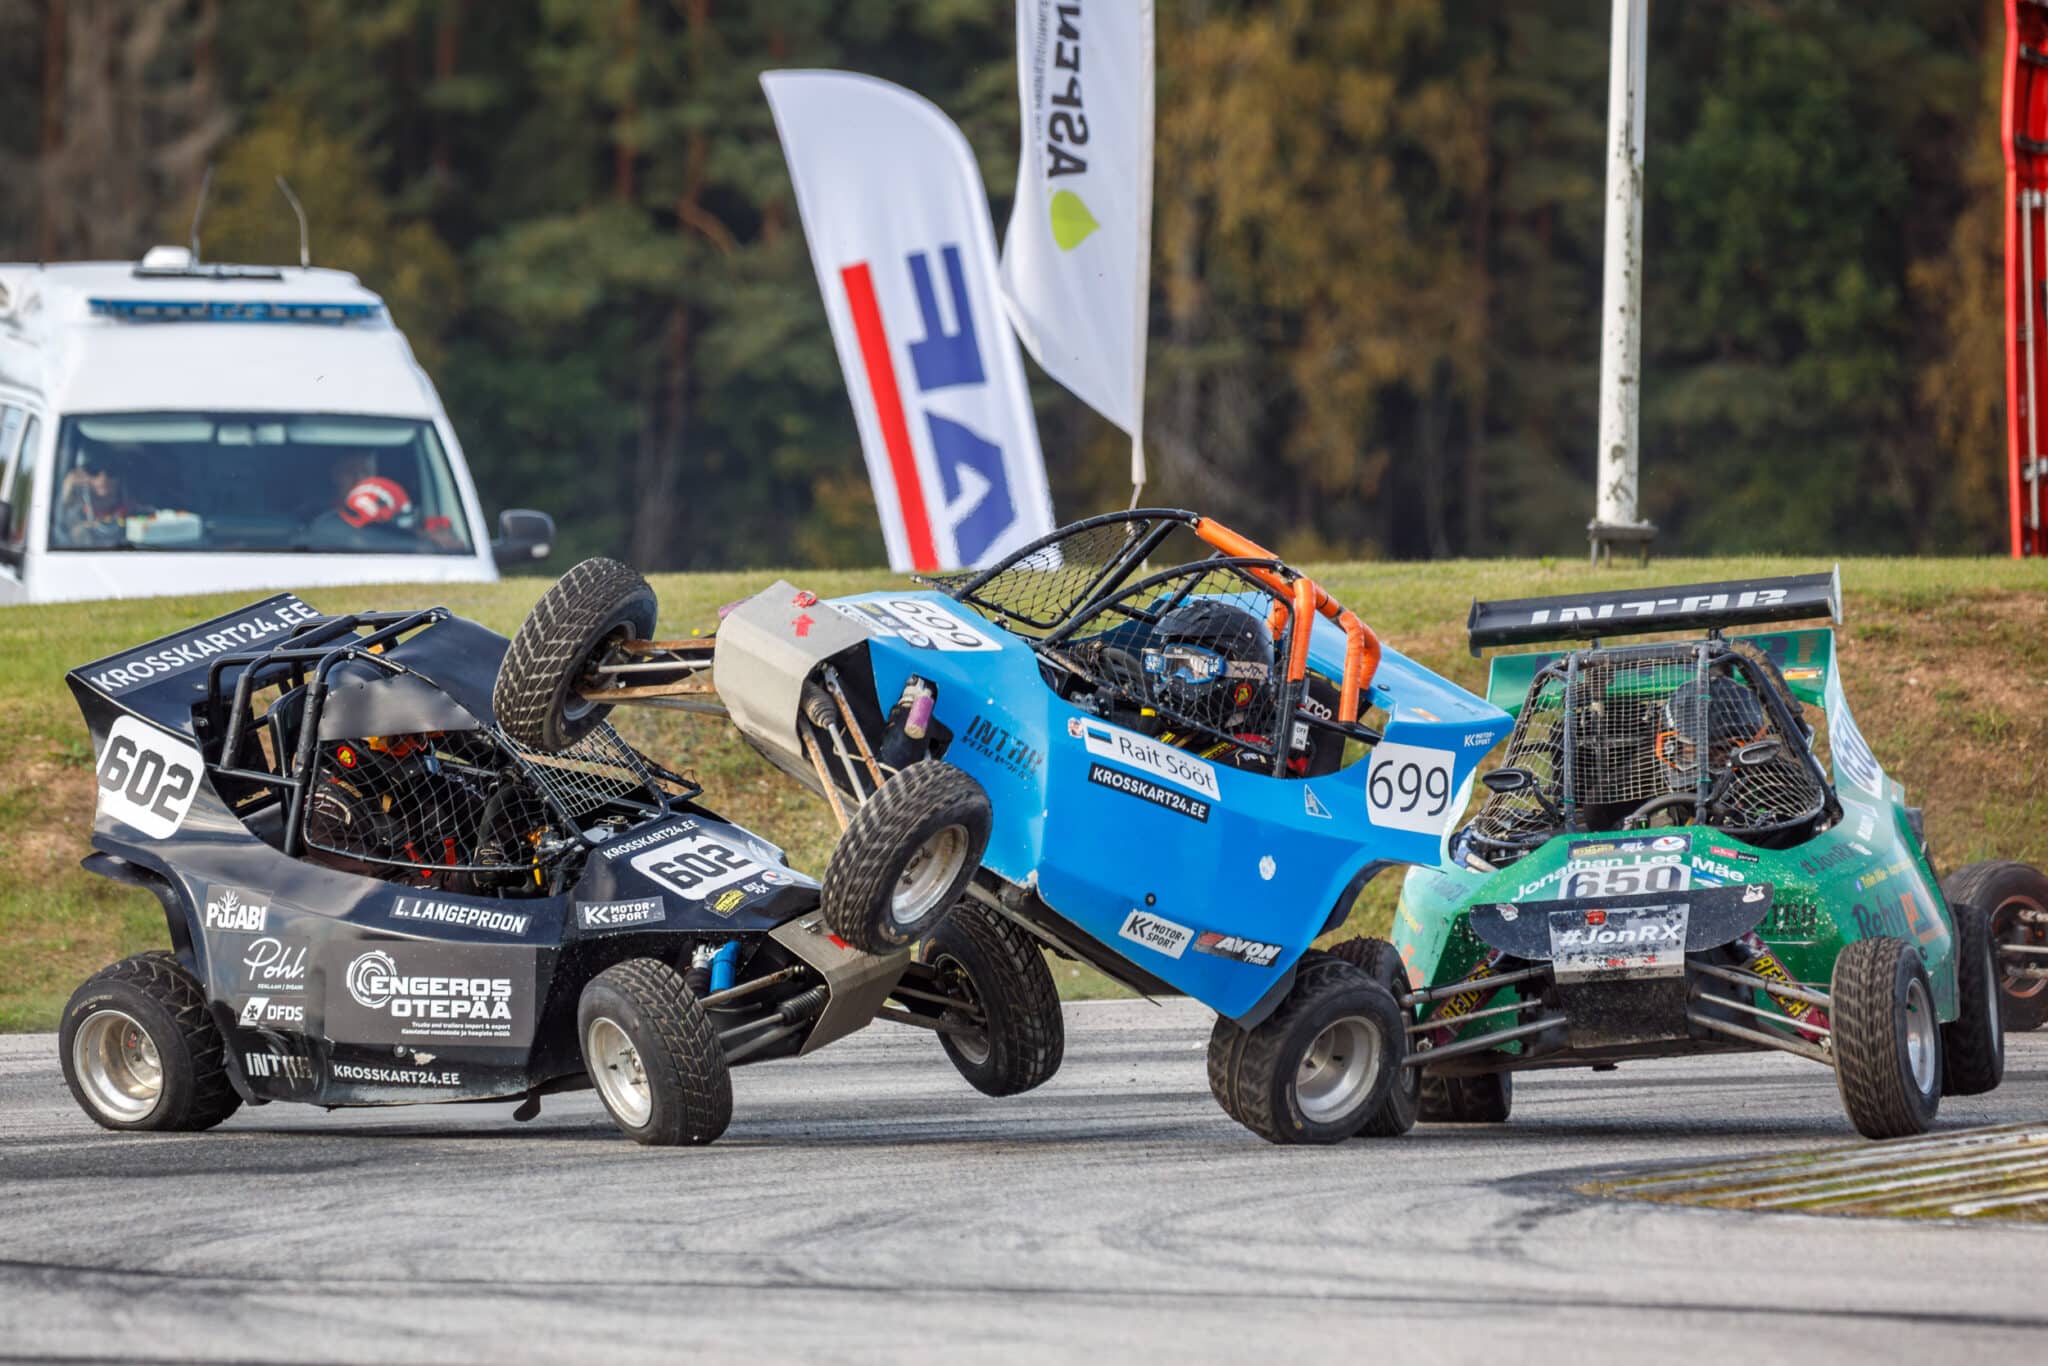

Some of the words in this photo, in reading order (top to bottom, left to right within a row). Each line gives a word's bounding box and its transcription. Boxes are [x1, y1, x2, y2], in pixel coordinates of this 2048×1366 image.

[90, 600, 319, 691] KROSSKART24.EE
[100, 735, 194, 824] 602
[1119, 736, 1162, 768] Rait
[1166, 754, 1214, 791] Sööt
[1093, 767, 1206, 819] KROSSKART24.EE
[1369, 760, 1449, 816] 699
[602, 819, 699, 860] KROSSKART24.EE
[649, 844, 752, 890] 602
[1511, 857, 1623, 902] Jonathan
[1633, 853, 1682, 867] Lee
[1691, 855, 1745, 883] Mäe
[1567, 866, 1682, 899] 650
[412, 900, 527, 934] LANGEPROON
[611, 912, 649, 923] SPORT
[1146, 932, 1176, 950] SPORT
[1215, 936, 1282, 960] AVON
[1559, 923, 1682, 946] #JonRX
[370, 976, 512, 997] ENGEROS
[267, 1006, 303, 1021] DFDS
[391, 996, 512, 1020] OTEPÄÄ
[334, 1065, 461, 1085] KROSSKART24.EE
